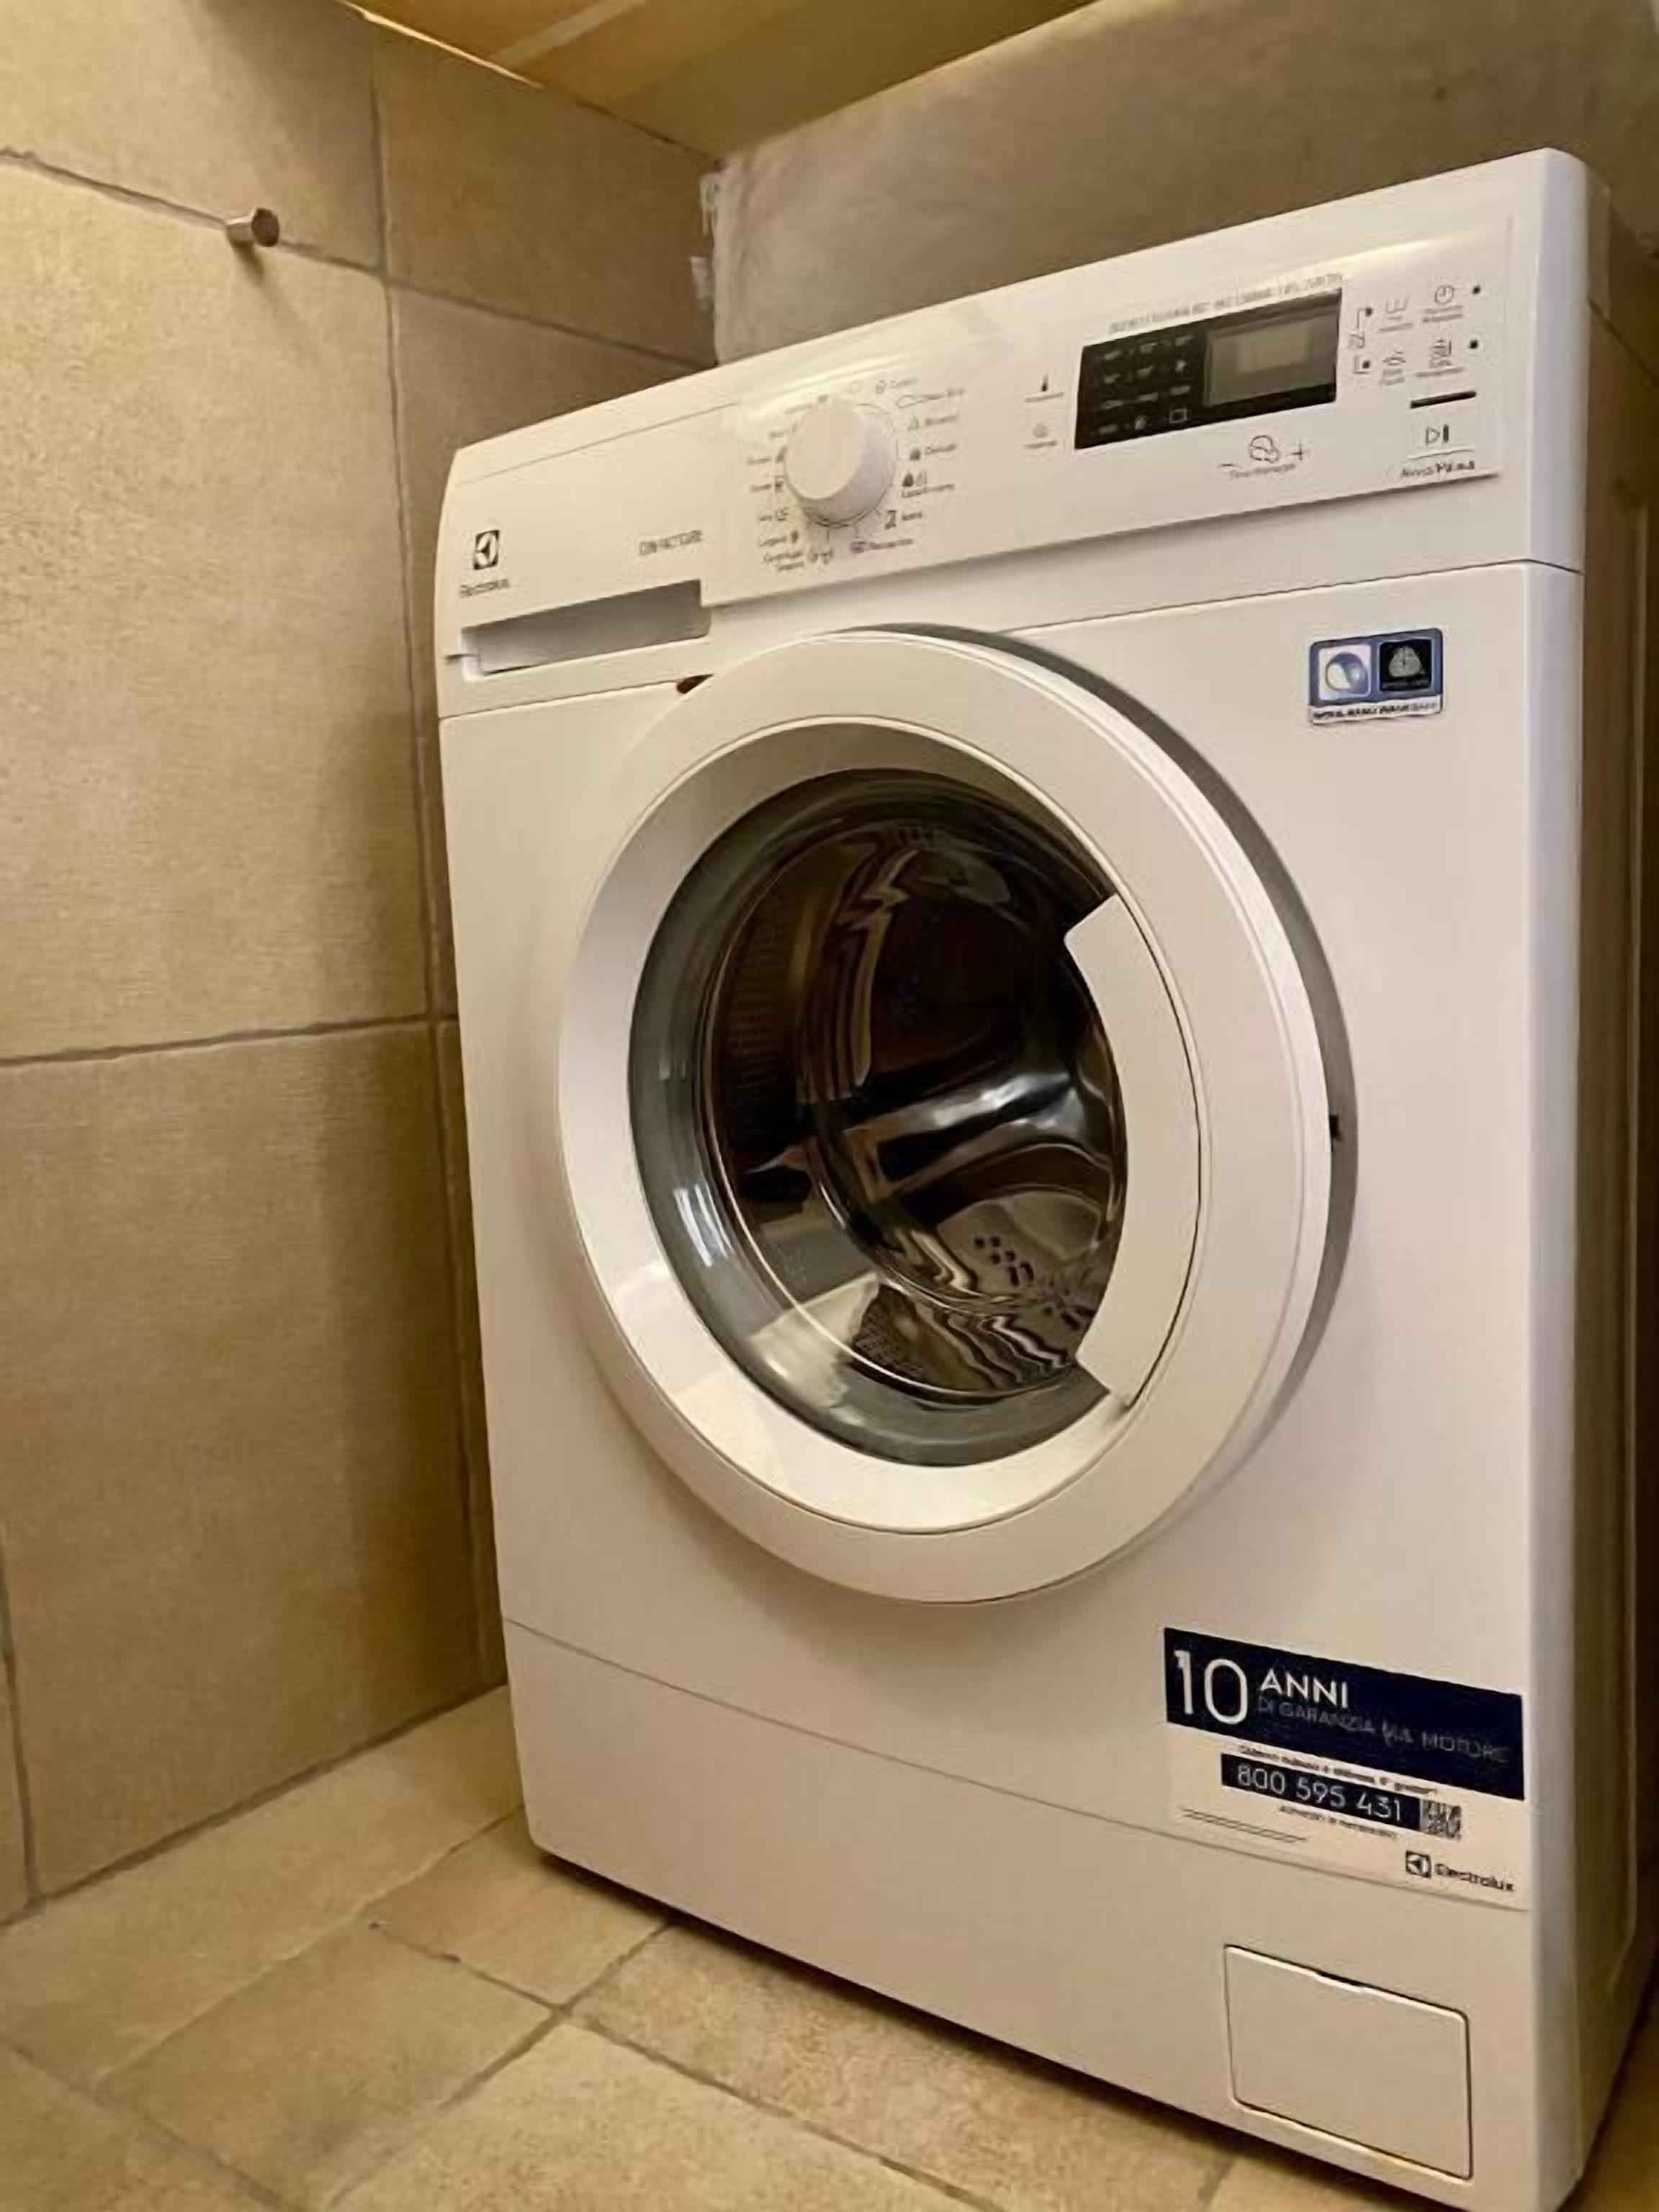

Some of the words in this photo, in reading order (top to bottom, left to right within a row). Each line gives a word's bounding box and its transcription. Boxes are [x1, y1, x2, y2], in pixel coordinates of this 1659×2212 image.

[1174, 1650, 1249, 1725] 10
[1261, 1668, 1348, 1709] ANNI
[1238, 1764, 1286, 1795] 800
[1297, 1776, 1346, 1809] 595
[1356, 1791, 1401, 1822] 431
